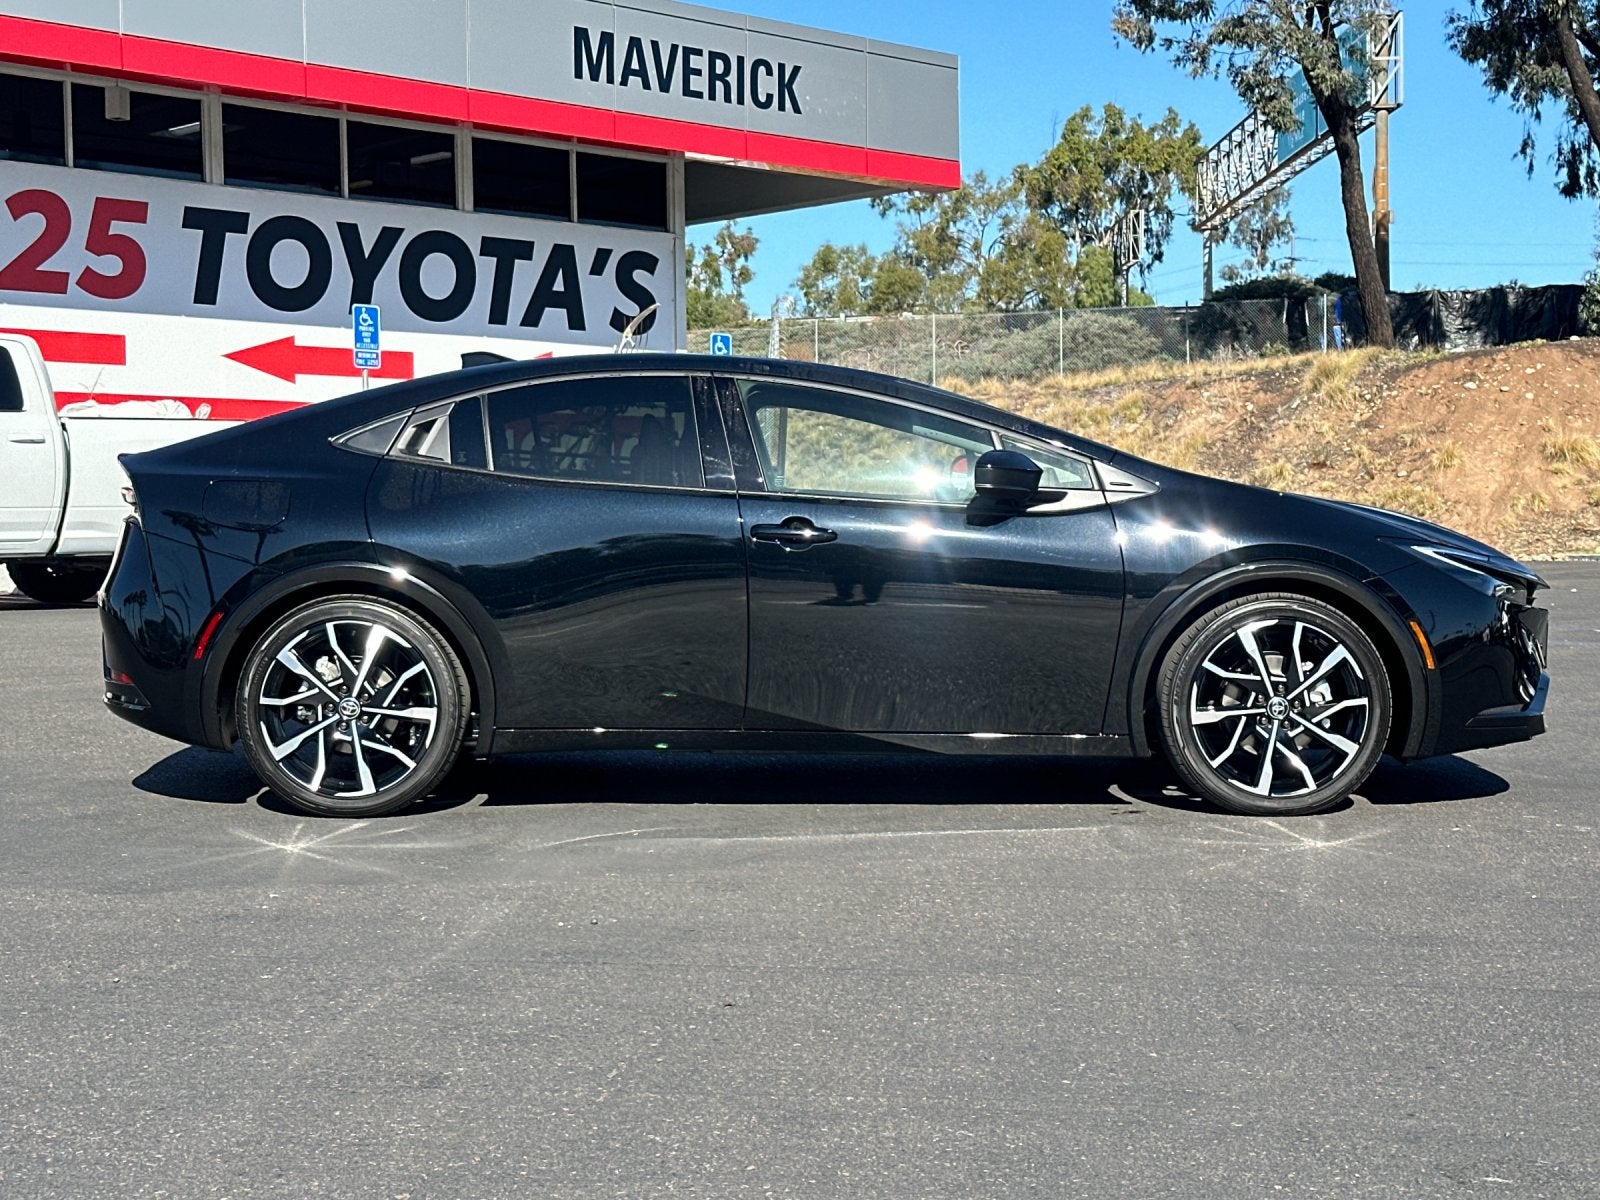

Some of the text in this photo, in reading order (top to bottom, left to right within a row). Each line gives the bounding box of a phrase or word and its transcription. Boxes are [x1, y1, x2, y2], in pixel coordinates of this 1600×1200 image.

[573, 25, 803, 115] MAVERICK
[0, 188, 660, 336] 25 TOYOTA'S
